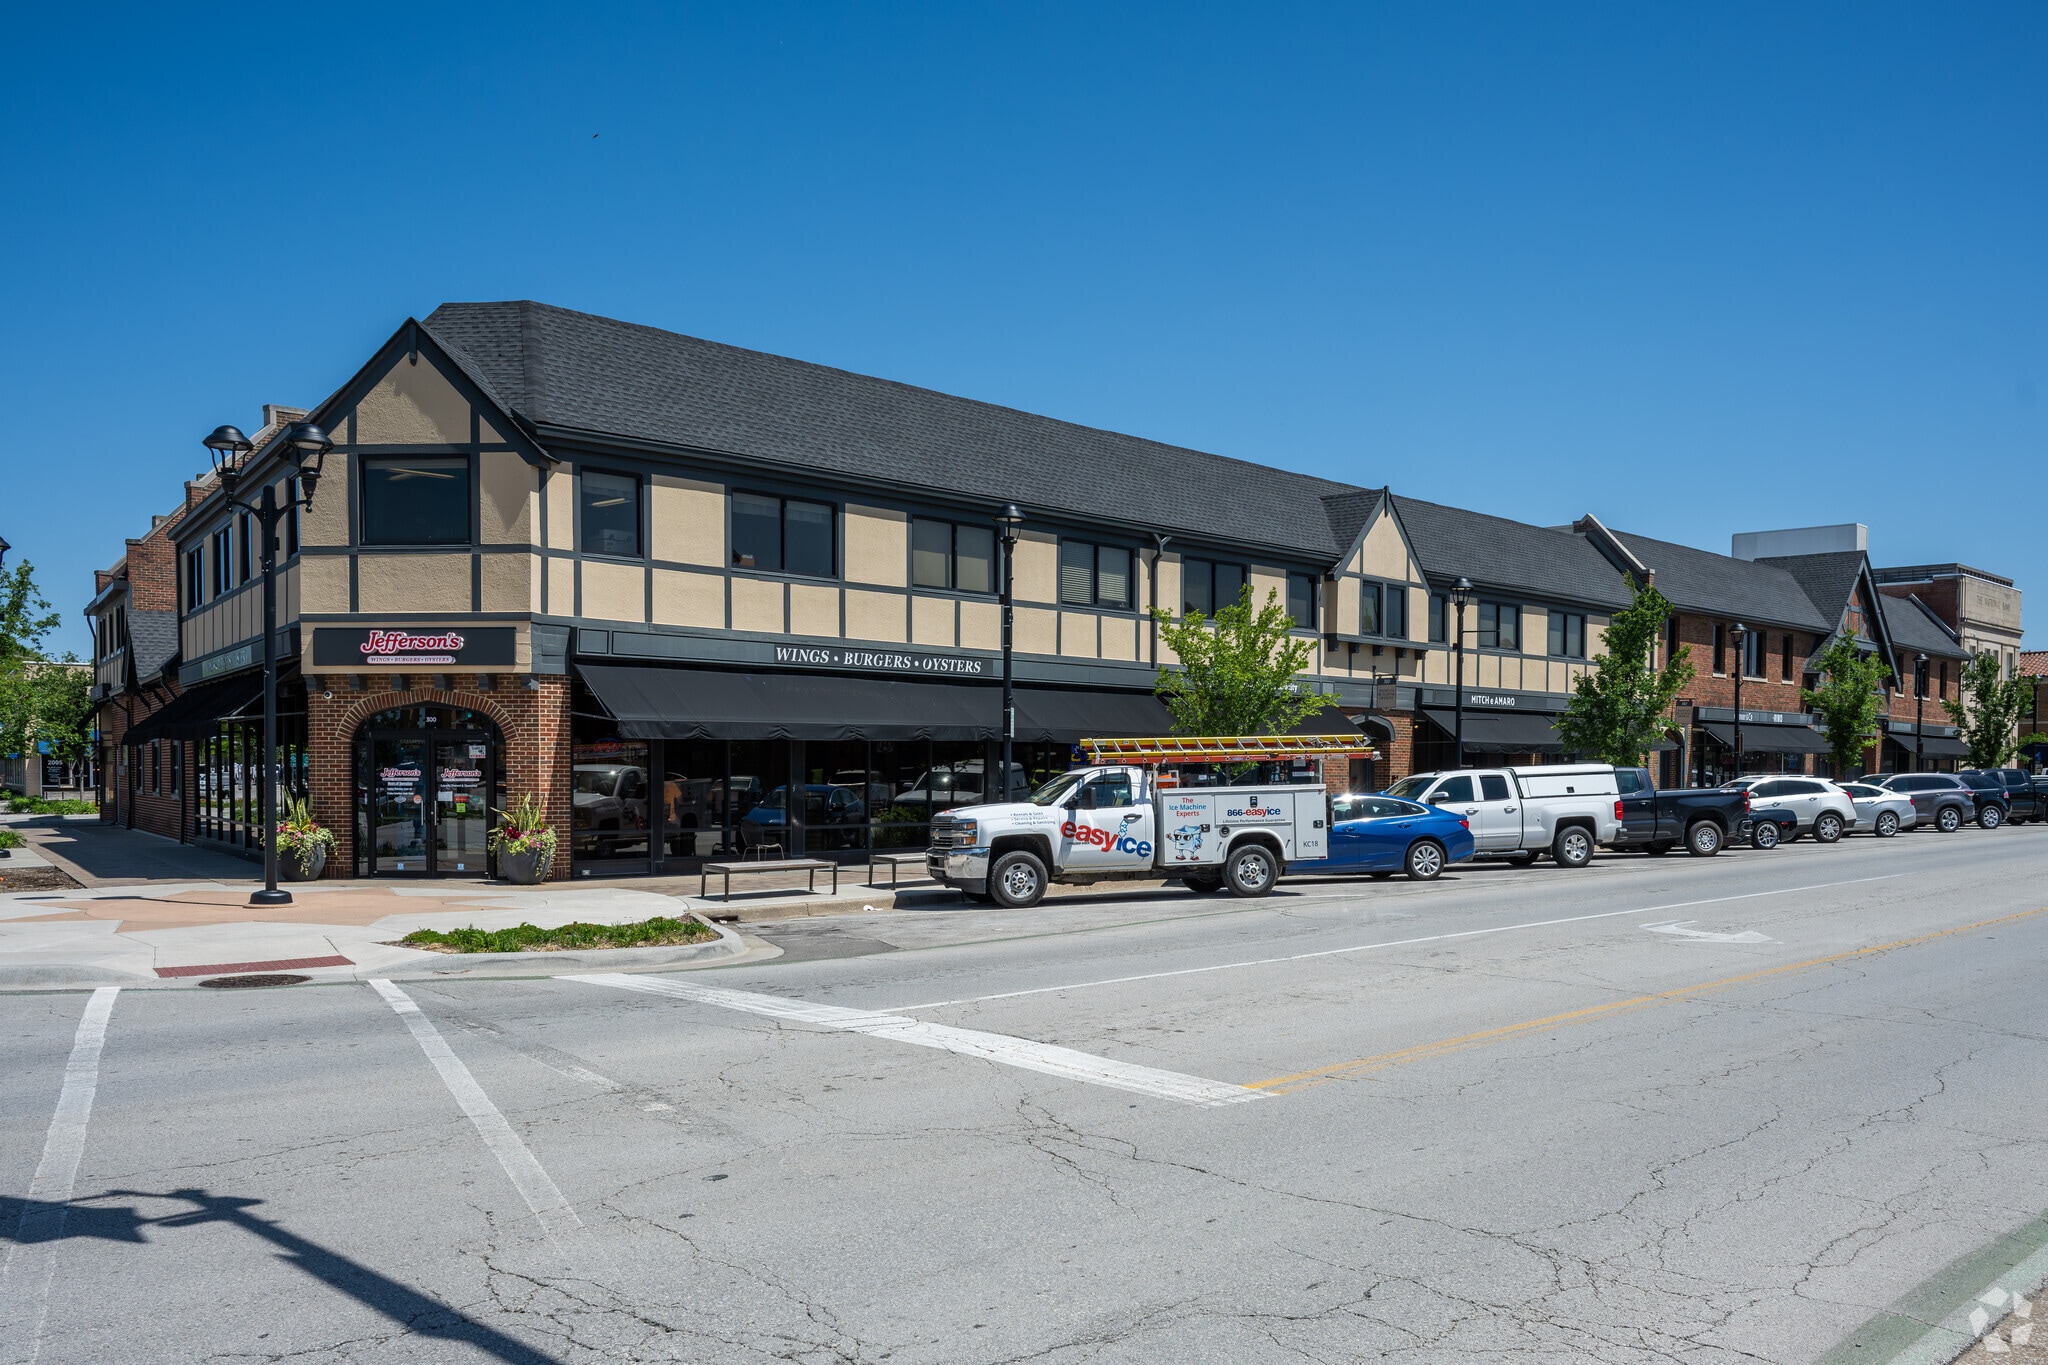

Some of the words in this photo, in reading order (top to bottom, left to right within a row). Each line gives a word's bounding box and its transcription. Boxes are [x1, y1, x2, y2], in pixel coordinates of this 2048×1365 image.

[1984, 597, 2001, 610] NATIONL
[360, 630, 463, 654] Jefferson's
[776, 647, 830, 664] WINGS
[843, 652, 912, 669] BURGERS
[922, 657, 982, 674] OYSTERS
[1471, 695, 1490, 705] MITCH
[1494, 696, 1516, 706] AMARO
[380, 767, 421, 778] Jefferson's
[441, 768, 482, 778] Jefferson's
[1227, 807, 1281, 817] 866-easyice
[1061, 821, 1152, 858] easyice
[1303, 840, 1319, 848] KC18
